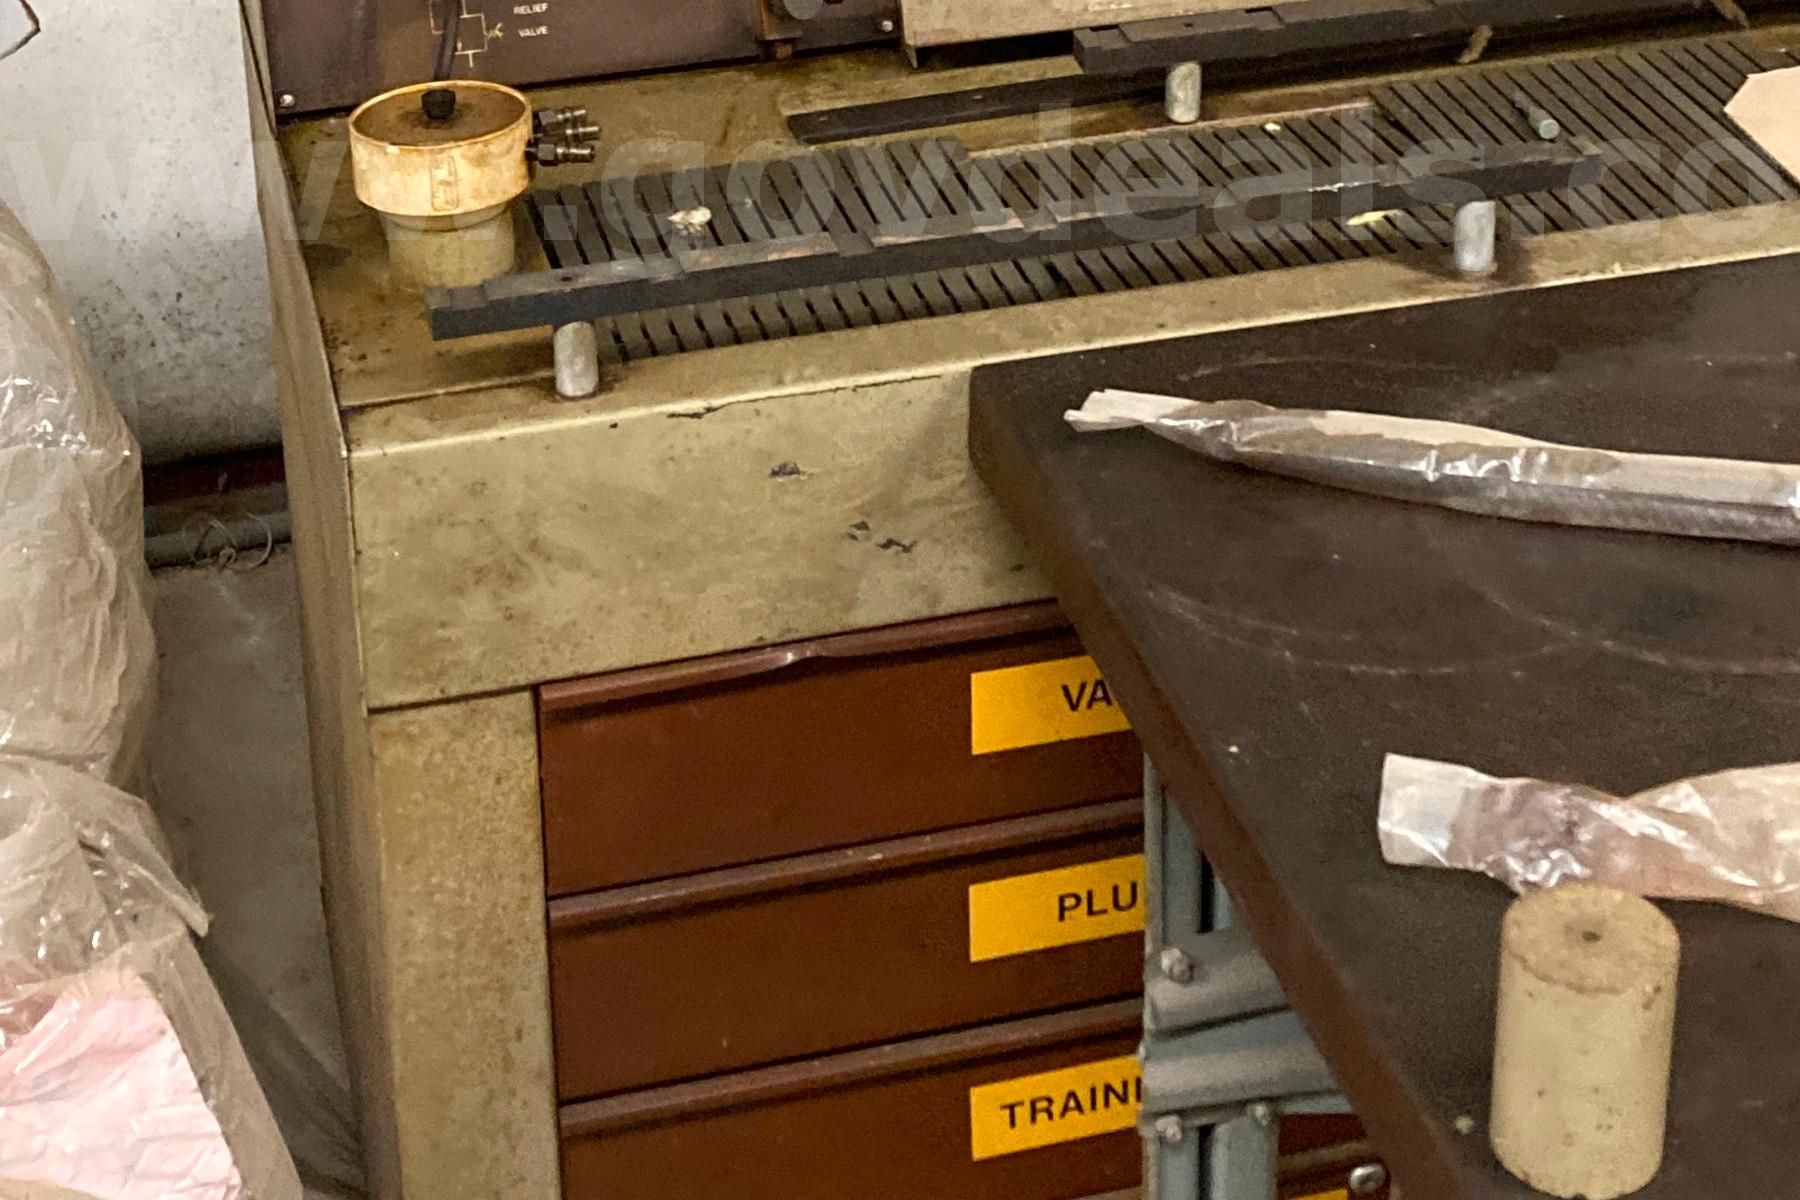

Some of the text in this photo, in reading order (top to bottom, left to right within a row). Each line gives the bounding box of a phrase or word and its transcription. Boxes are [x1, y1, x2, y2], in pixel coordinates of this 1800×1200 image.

[513, 3, 548, 15] RELIEF
[518, 25, 548, 38] VALVE
[1061, 679, 1113, 712] VA
[1058, 881, 1138, 922] PLU
